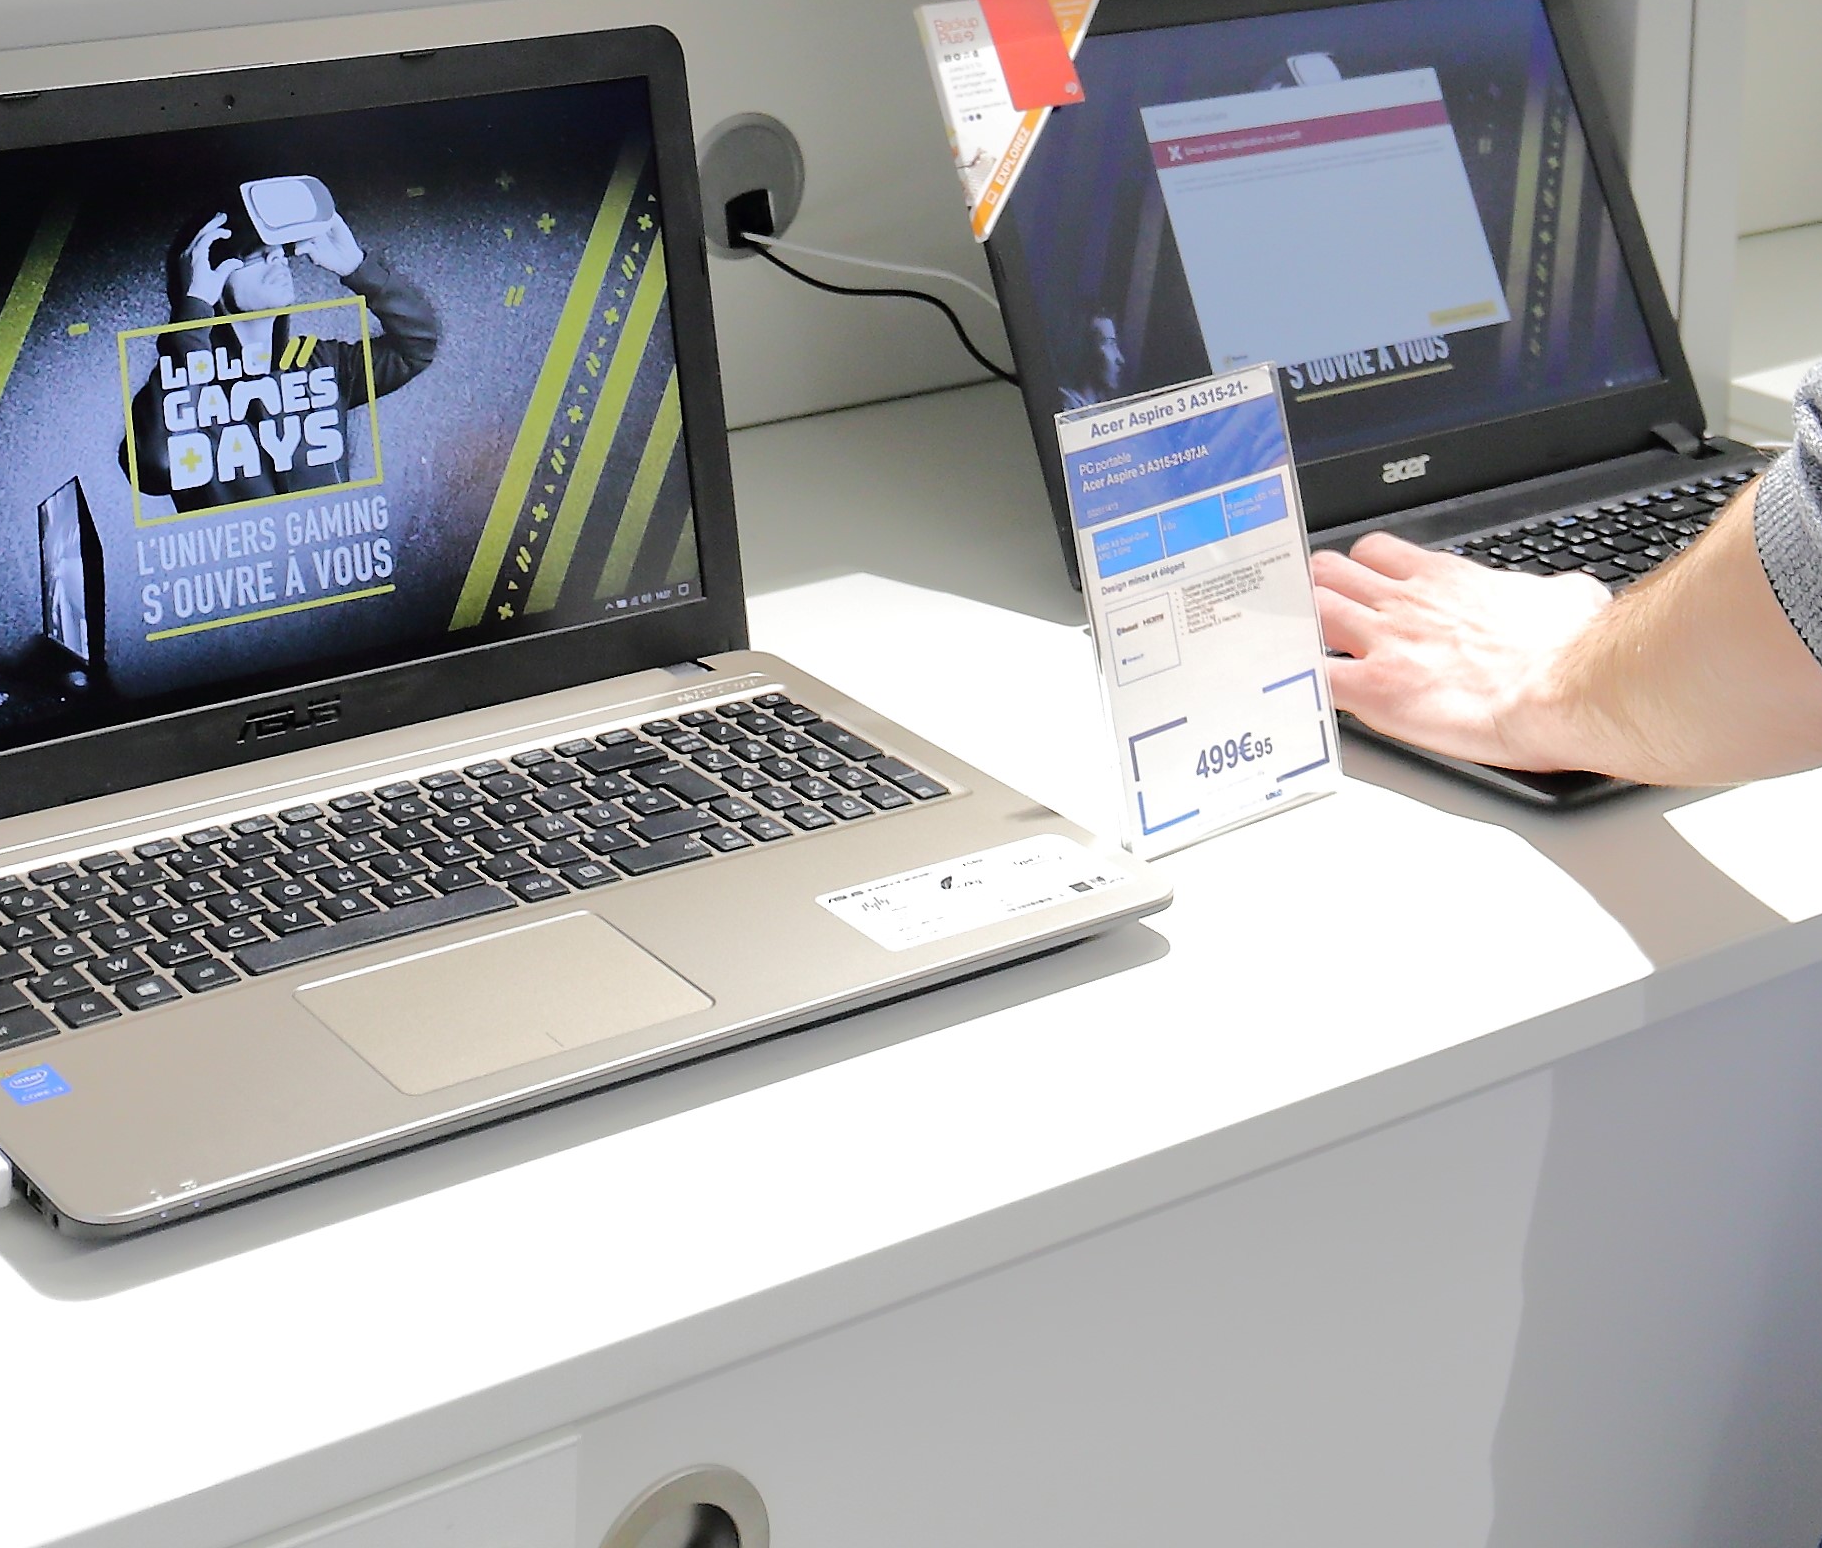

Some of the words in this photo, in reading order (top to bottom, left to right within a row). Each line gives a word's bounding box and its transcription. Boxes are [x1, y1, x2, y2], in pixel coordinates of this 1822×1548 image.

[934, 18, 978, 35] Backup
[938, 32, 963, 46] Plus
[995, 127, 1031, 186] EXPLOREZ
[159, 343, 272, 390] LDLC
[1289, 348, 1375, 390] SOUVRE
[163, 366, 339, 432] GAMES
[1090, 419, 1124, 438] Acer
[1129, 406, 1174, 428] Aspire
[1177, 399, 1186, 412] 3
[1189, 380, 1249, 409] A315-21-
[167, 409, 344, 490] DAYS
[1079, 463, 1095, 476] PC
[1097, 452, 1132, 472] portable
[1381, 454, 1430, 484] acer
[1082, 478, 1105, 493] Acer
[1106, 469, 1137, 488] Aspire
[1139, 464, 1146, 475] 3
[136, 516, 276, 576] L'UNIVERS
[285, 495, 389, 547] GAMING
[141, 561, 276, 625] S'OUVRE
[285, 550, 307, 597] À
[312, 538, 394, 591] VOUS
[1101, 578, 1126, 596] Design
[1128, 573, 1150, 588] mince
[1151, 570, 1159, 581] et
[1159, 562, 1186, 580] élégant
[236, 694, 343, 745] ASUS
[1196, 732, 1273, 779] 499€95
